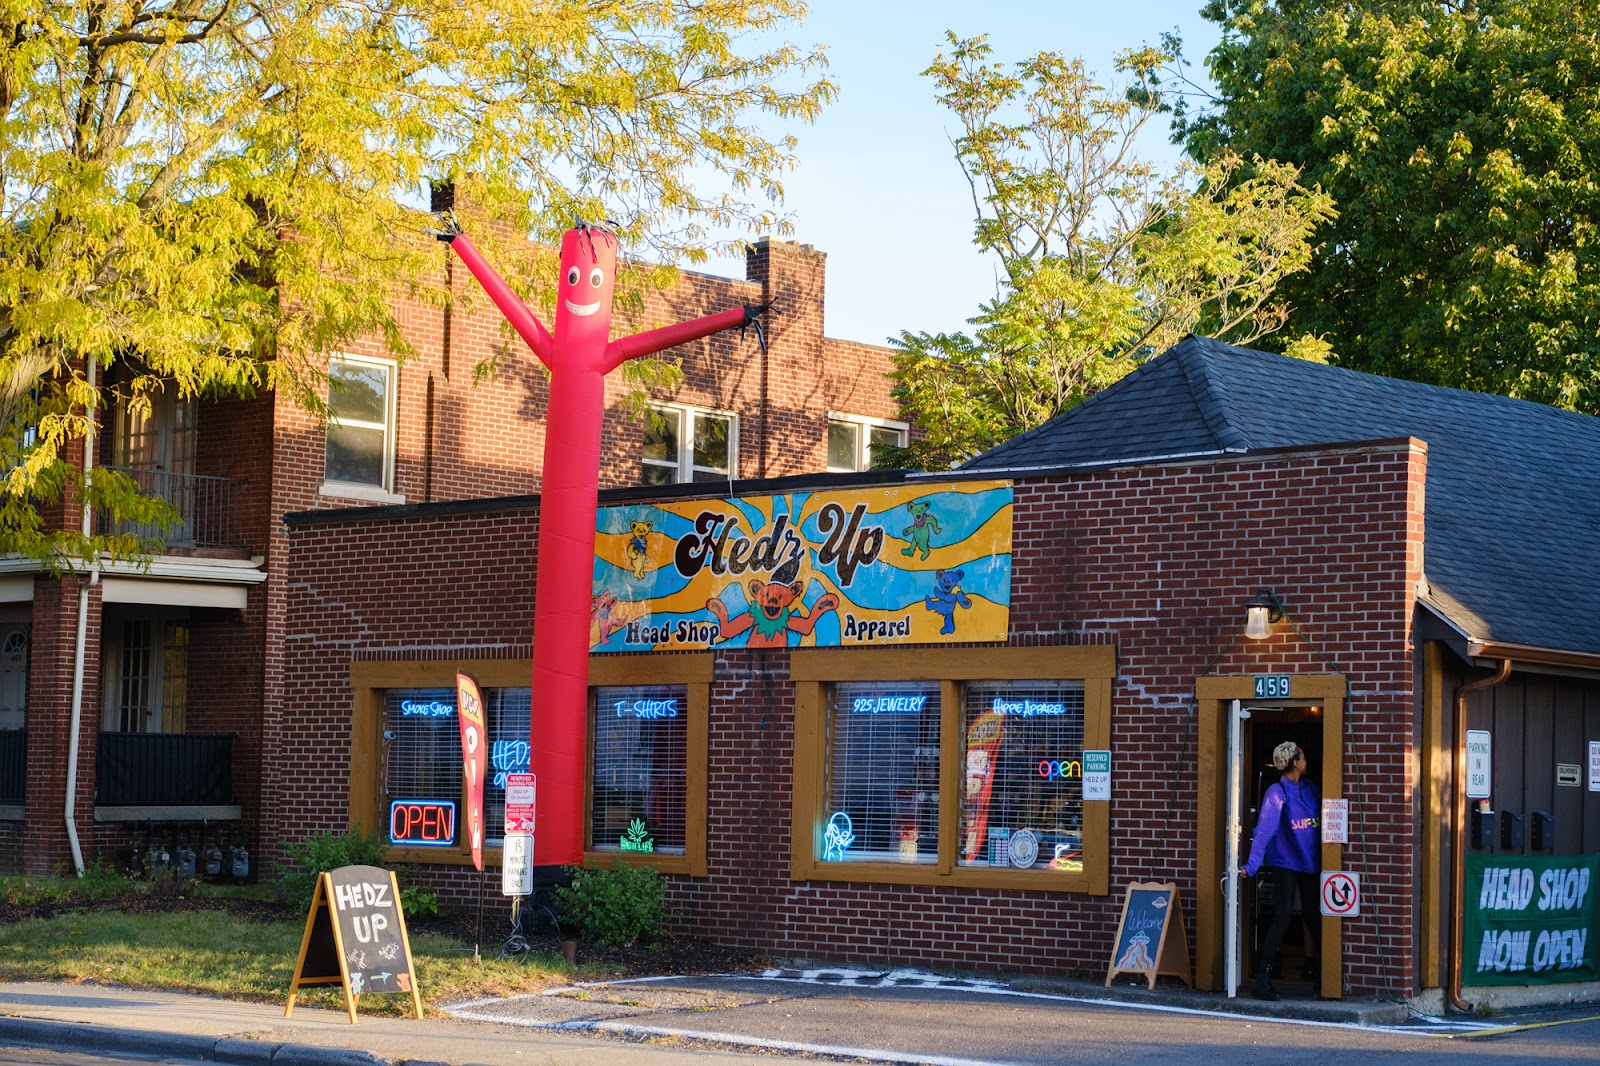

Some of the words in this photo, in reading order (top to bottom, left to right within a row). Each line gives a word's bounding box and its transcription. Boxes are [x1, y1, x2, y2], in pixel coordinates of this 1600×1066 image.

[675, 509, 806, 587] Hedz
[817, 503, 885, 588] Up
[625, 621, 669, 645] Head
[677, 620, 720, 646] Shop
[844, 615, 911, 641] Apparel
[1256, 678, 1289, 696] 459
[853, 698, 874, 713] 925
[873, 695, 927, 714] JEWELRY
[1469, 743, 1488, 754] PARKING
[1086, 754, 1108, 762] RESERVED
[1475, 759, 1481, 769] IN
[1039, 760, 1081, 782] open
[1087, 762, 1107, 770] PARKING
[1472, 774, 1485, 786] REAR
[1323, 801, 1347, 809] ADDITIONAL
[1326, 812, 1343, 820] PARKING
[392, 805, 453, 841] OPEN
[1327, 822, 1341, 830] BEHIND
[1325, 833, 1343, 841] BUILDING
[515, 841, 523, 854] 15
[510, 856, 527, 865] MINUTE
[508, 867, 528, 876] PARKING
[511, 879, 523, 888] ONLY
[1480, 867, 1534, 910] HEAD
[1538, 867, 1590, 910] SHOP
[335, 883, 393, 910] HEDZ
[1128, 908, 1164, 931] Welcome
[353, 913, 388, 943] UP
[1477, 929, 1532, 972] NOW
[1533, 928, 1587, 972] OPEN
